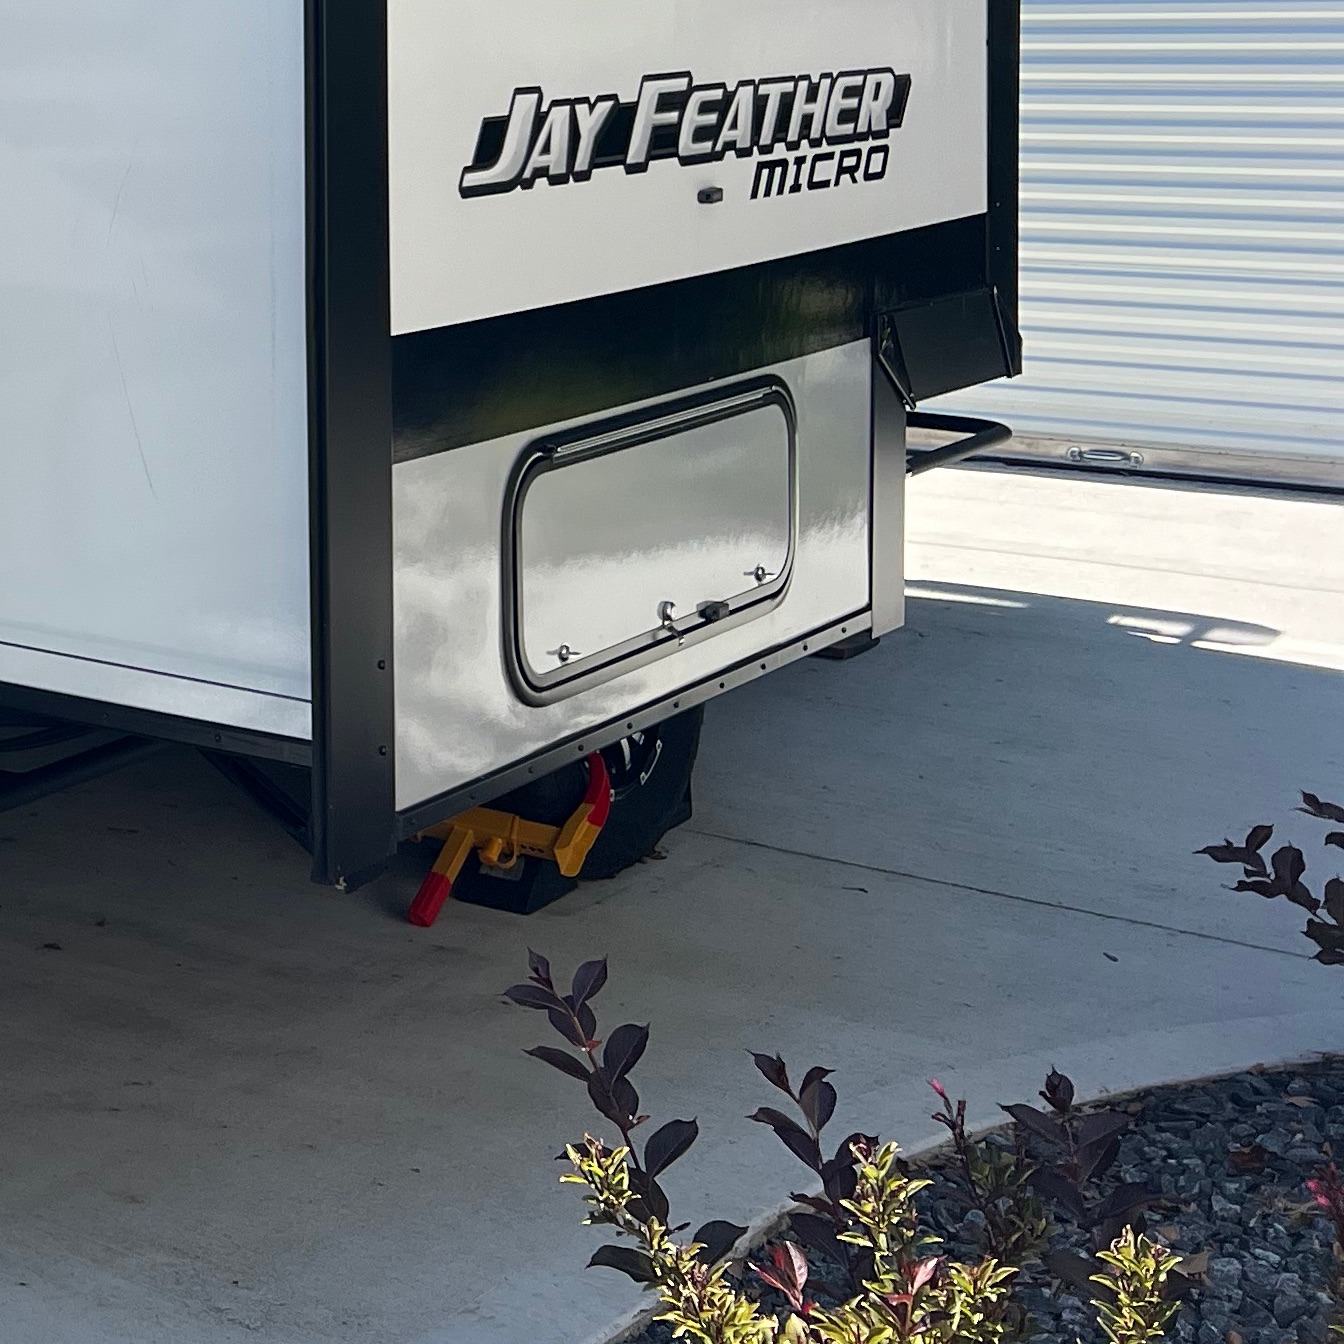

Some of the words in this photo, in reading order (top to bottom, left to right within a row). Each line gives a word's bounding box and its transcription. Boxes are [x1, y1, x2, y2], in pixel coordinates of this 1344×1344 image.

[459, 86, 620, 199] JAY
[624, 70, 902, 175] FEATHER
[750, 144, 890, 200] MICRO
